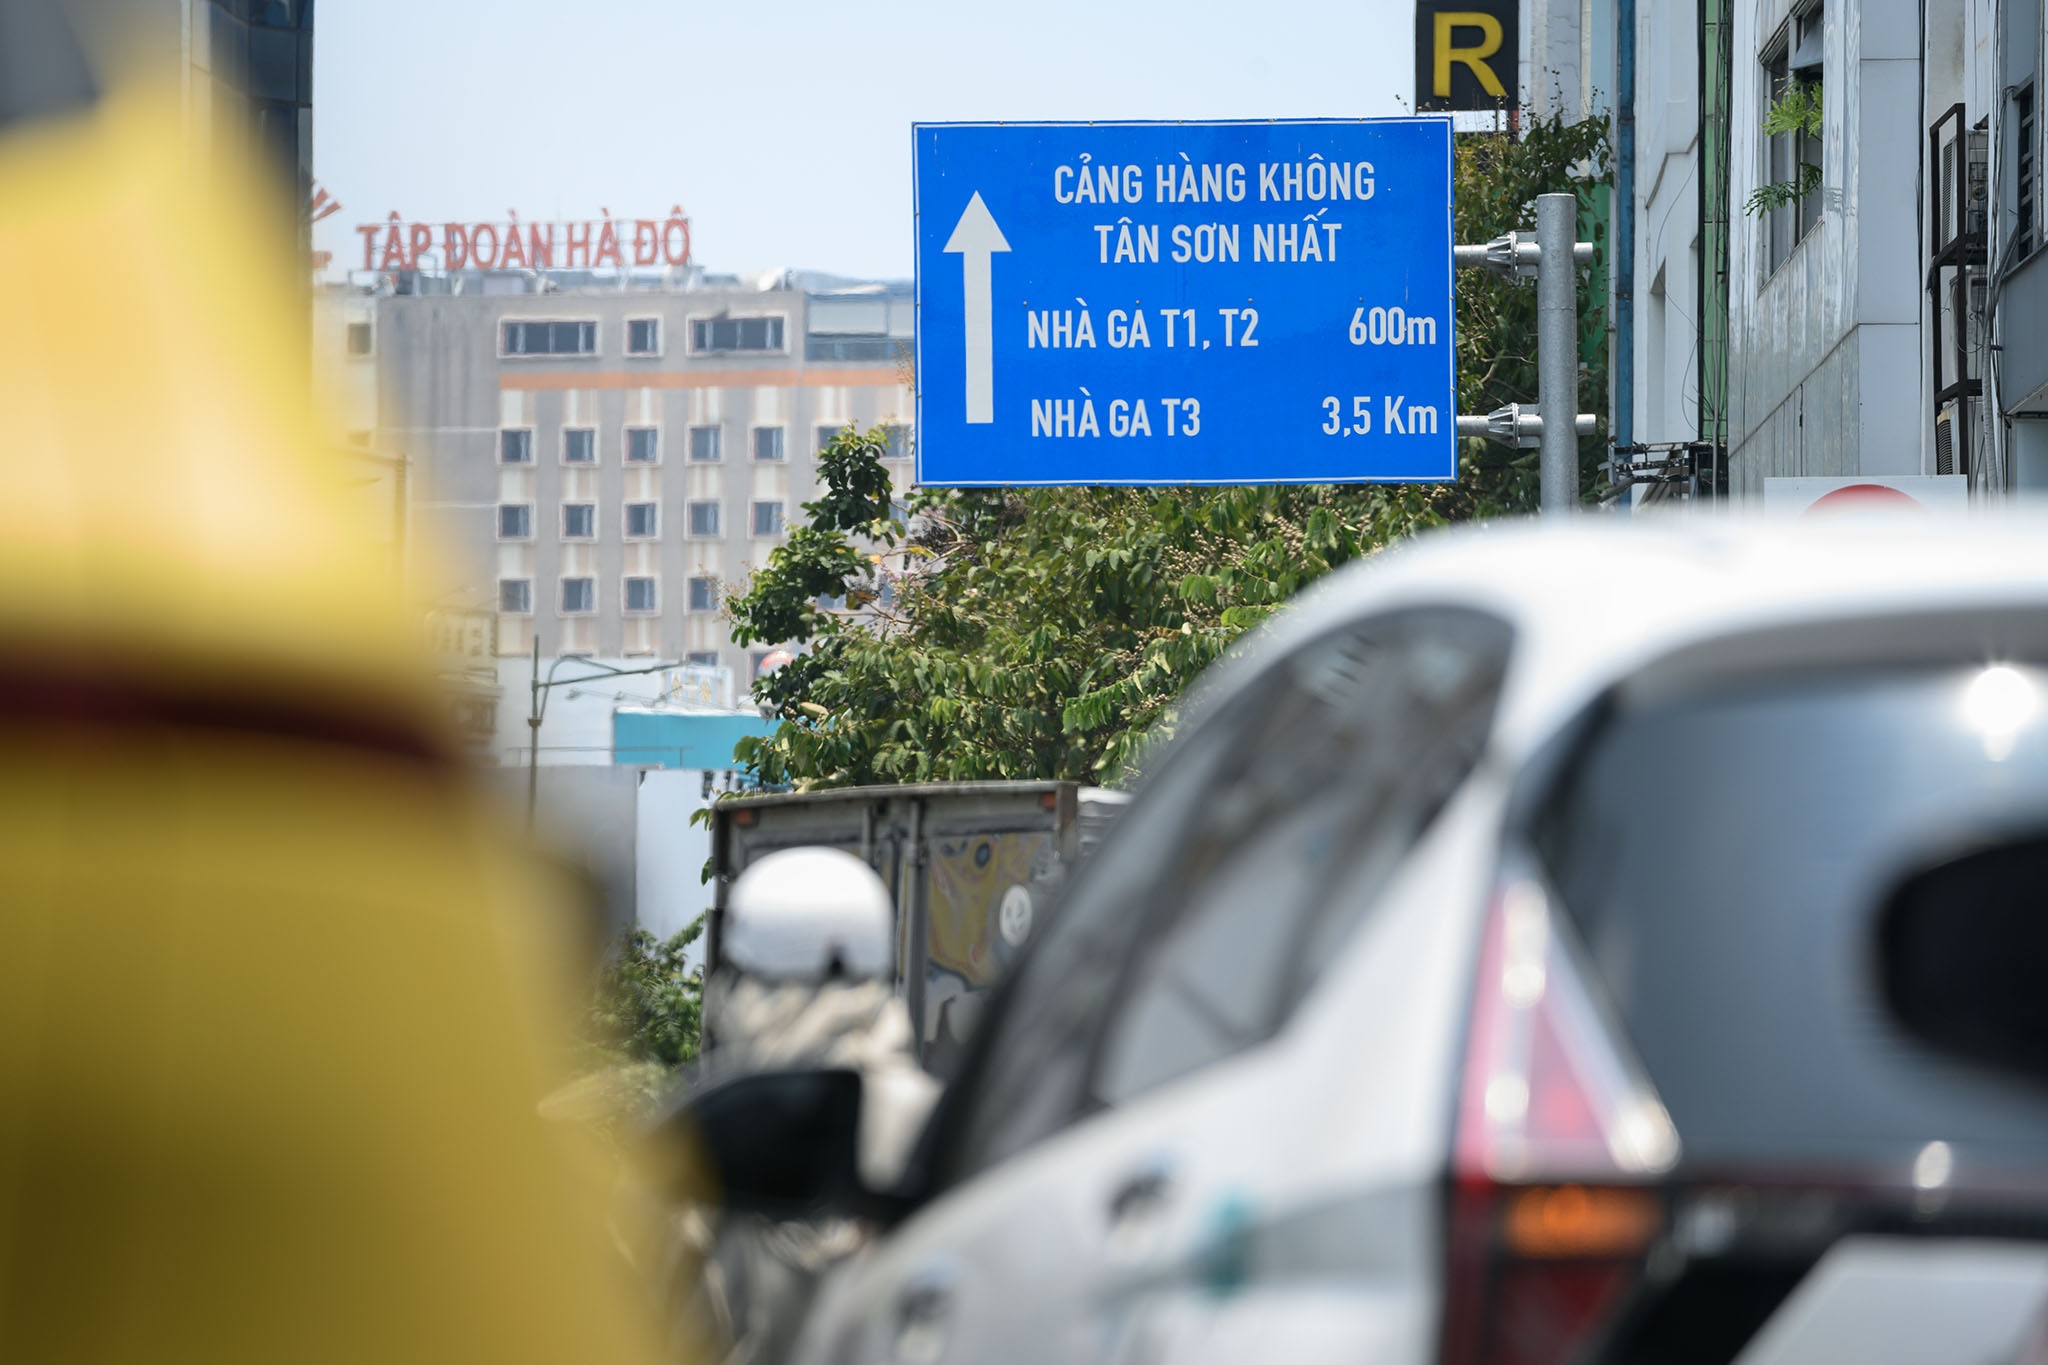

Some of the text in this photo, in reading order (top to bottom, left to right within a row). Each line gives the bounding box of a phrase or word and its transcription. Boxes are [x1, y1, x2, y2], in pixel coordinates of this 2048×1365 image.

[1433, 11, 1507, 97] R
[1055, 152, 1375, 203] CẢNG HÀNG KHÔNG
[443, 209, 553, 271] ĐOÀN
[566, 207, 623, 268] HÀ
[633, 204, 690, 266] ĐÔ
[1095, 208, 1342, 263] TÂN SƠN NHẤT
[1028, 298, 1436, 350] NHÀ GA T1, T2 600m
[1031, 387, 1437, 437] NHÀ GA T3 3,5 Km
